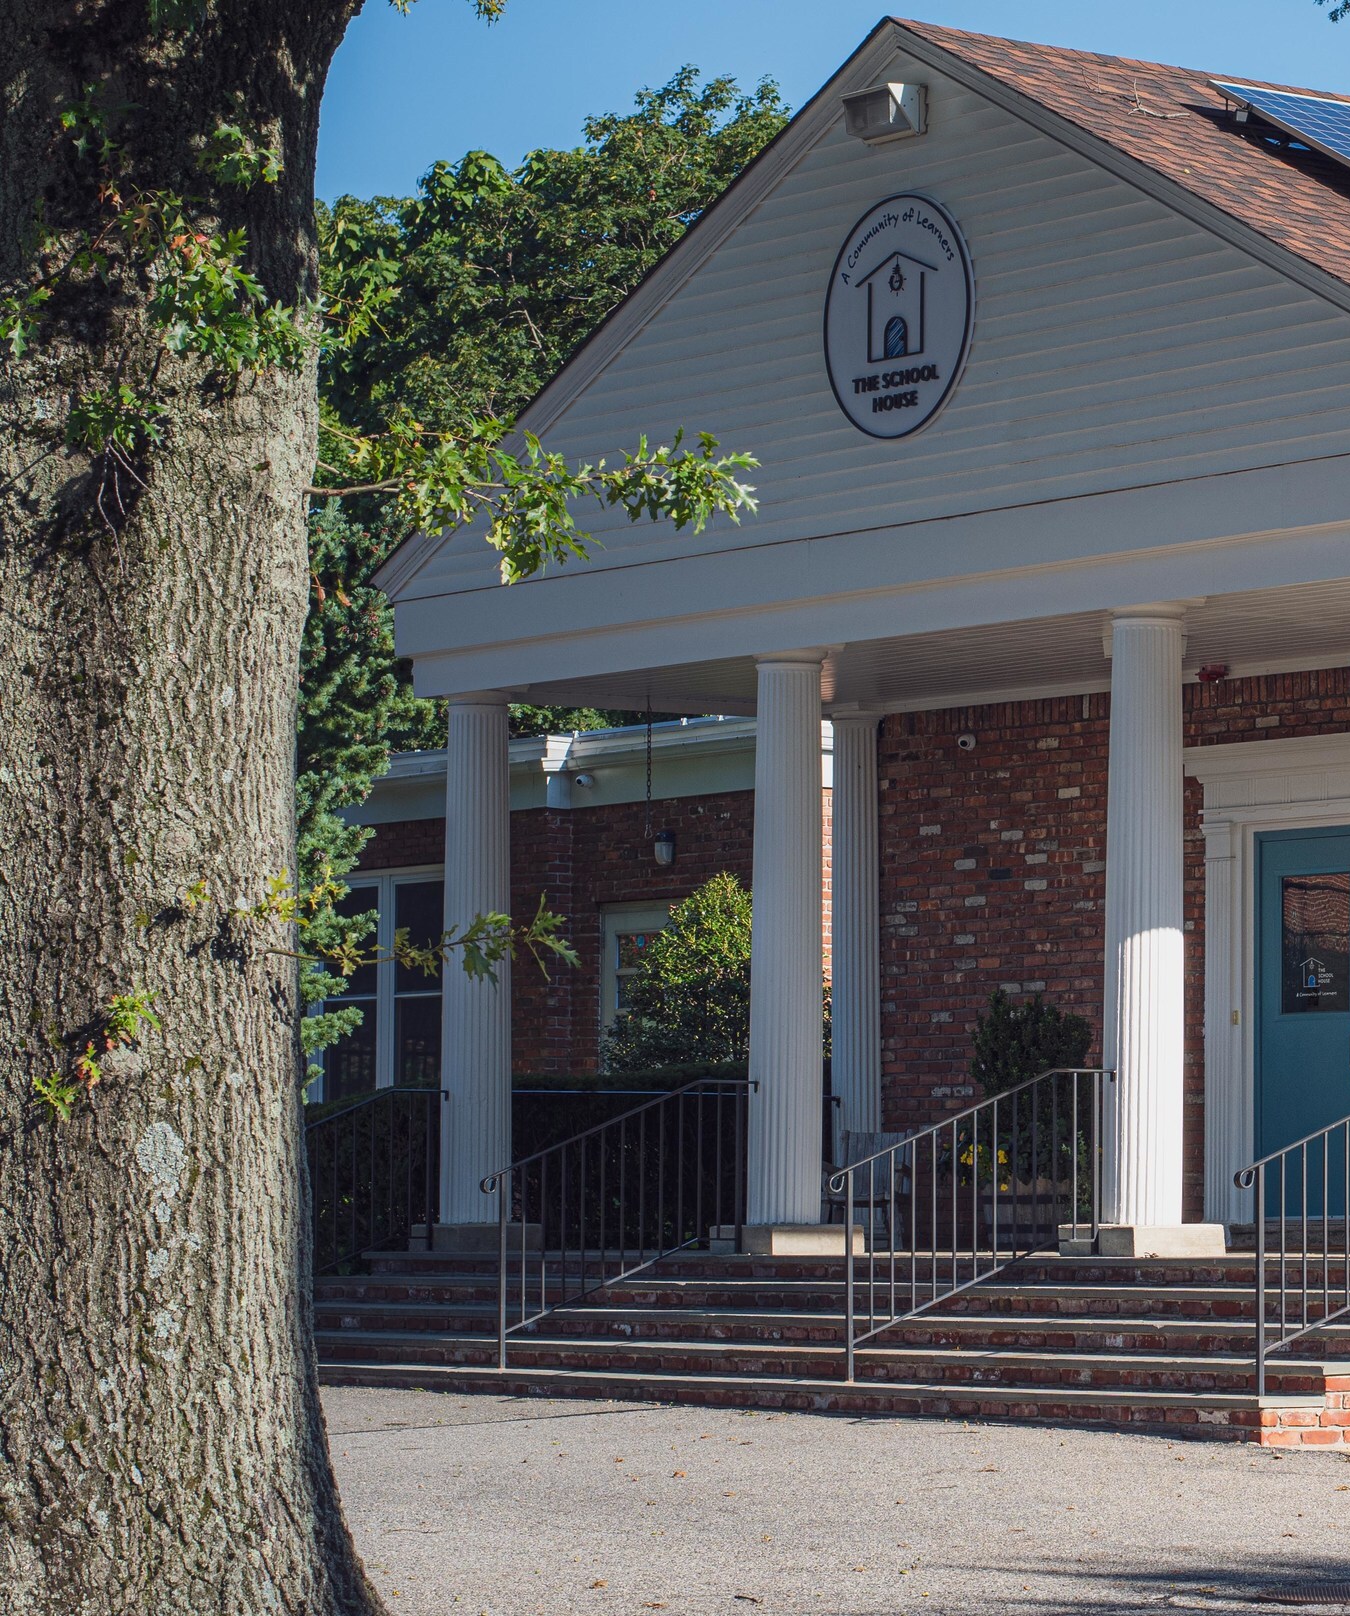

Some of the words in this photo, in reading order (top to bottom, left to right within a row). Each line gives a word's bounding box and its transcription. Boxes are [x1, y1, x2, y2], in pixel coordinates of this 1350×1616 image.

[841, 272, 850, 285] A
[848, 213, 899, 268] Community
[902, 207, 914, 222] of
[916, 210, 955, 261] Learners
[852, 375, 880, 394] THE
[882, 364, 939, 389] SCHOOL
[872, 390, 918, 413] HOUSE
